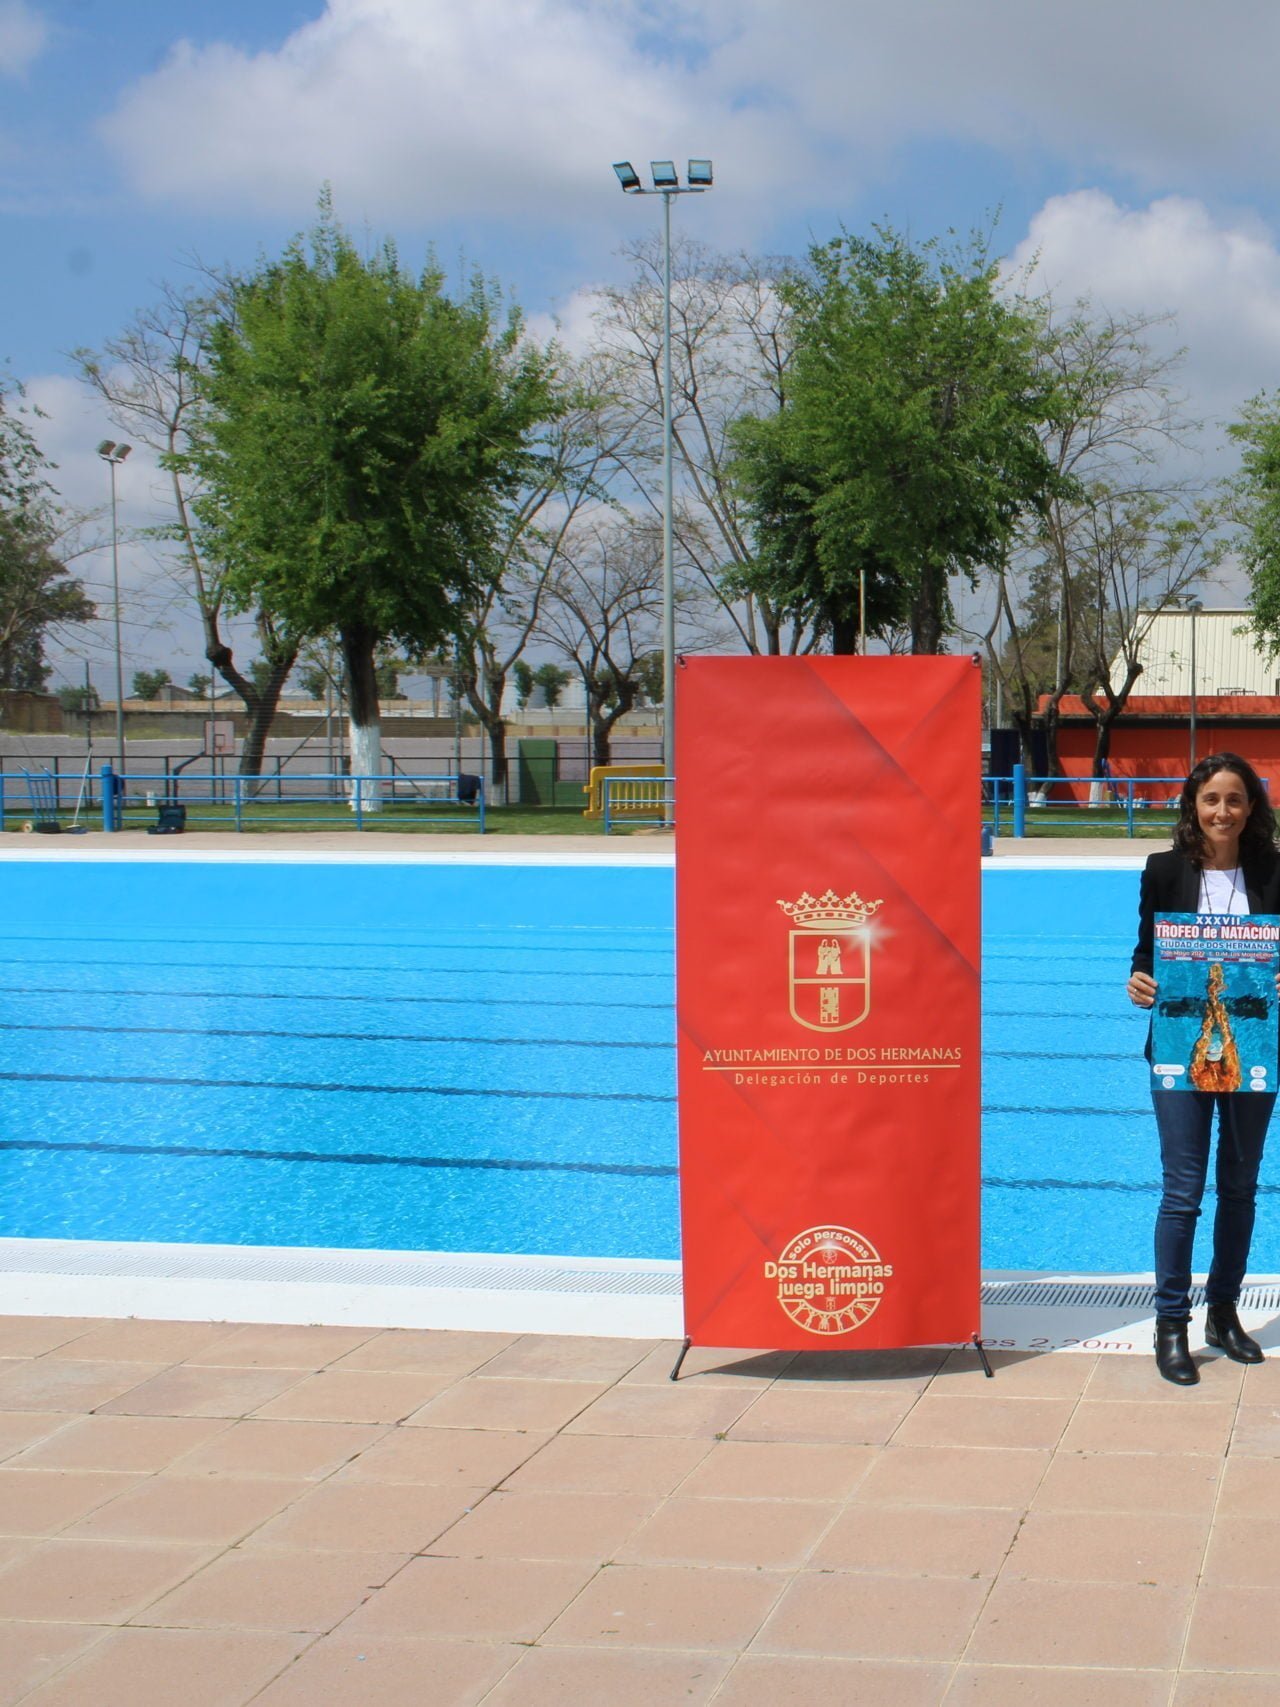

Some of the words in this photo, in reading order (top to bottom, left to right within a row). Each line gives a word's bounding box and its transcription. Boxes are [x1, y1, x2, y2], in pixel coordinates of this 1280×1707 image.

[1196, 916, 1240, 925] XXXVII
[1155, 925, 1199, 938] TROFEO
[1203, 926, 1217, 938] de
[1221, 924, 1279, 940] NATACIÓN
[1207, 941, 1224, 949] DOS
[1226, 942, 1274, 950] HERMANAS
[703, 1049, 820, 1062] AYUNTAMIENTO
[825, 1048, 842, 1061] DE
[847, 1048, 877, 1061] DOS
[881, 1047, 961, 1061] HERMANAS
[735, 1073, 821, 1087] Delegación
[831, 1072, 848, 1084] de
[857, 1072, 929, 1086] Deportes
[789, 1237, 811, 1260] solo
[813, 1231, 869, 1258] personas
[764, 1262, 798, 1278] Dos
[802, 1262, 893, 1278] Hermanas
[777, 1278, 824, 1299] juega
[830, 1278, 884, 1298] limpio
[1029, 1337, 1133, 1350] 2.20m
